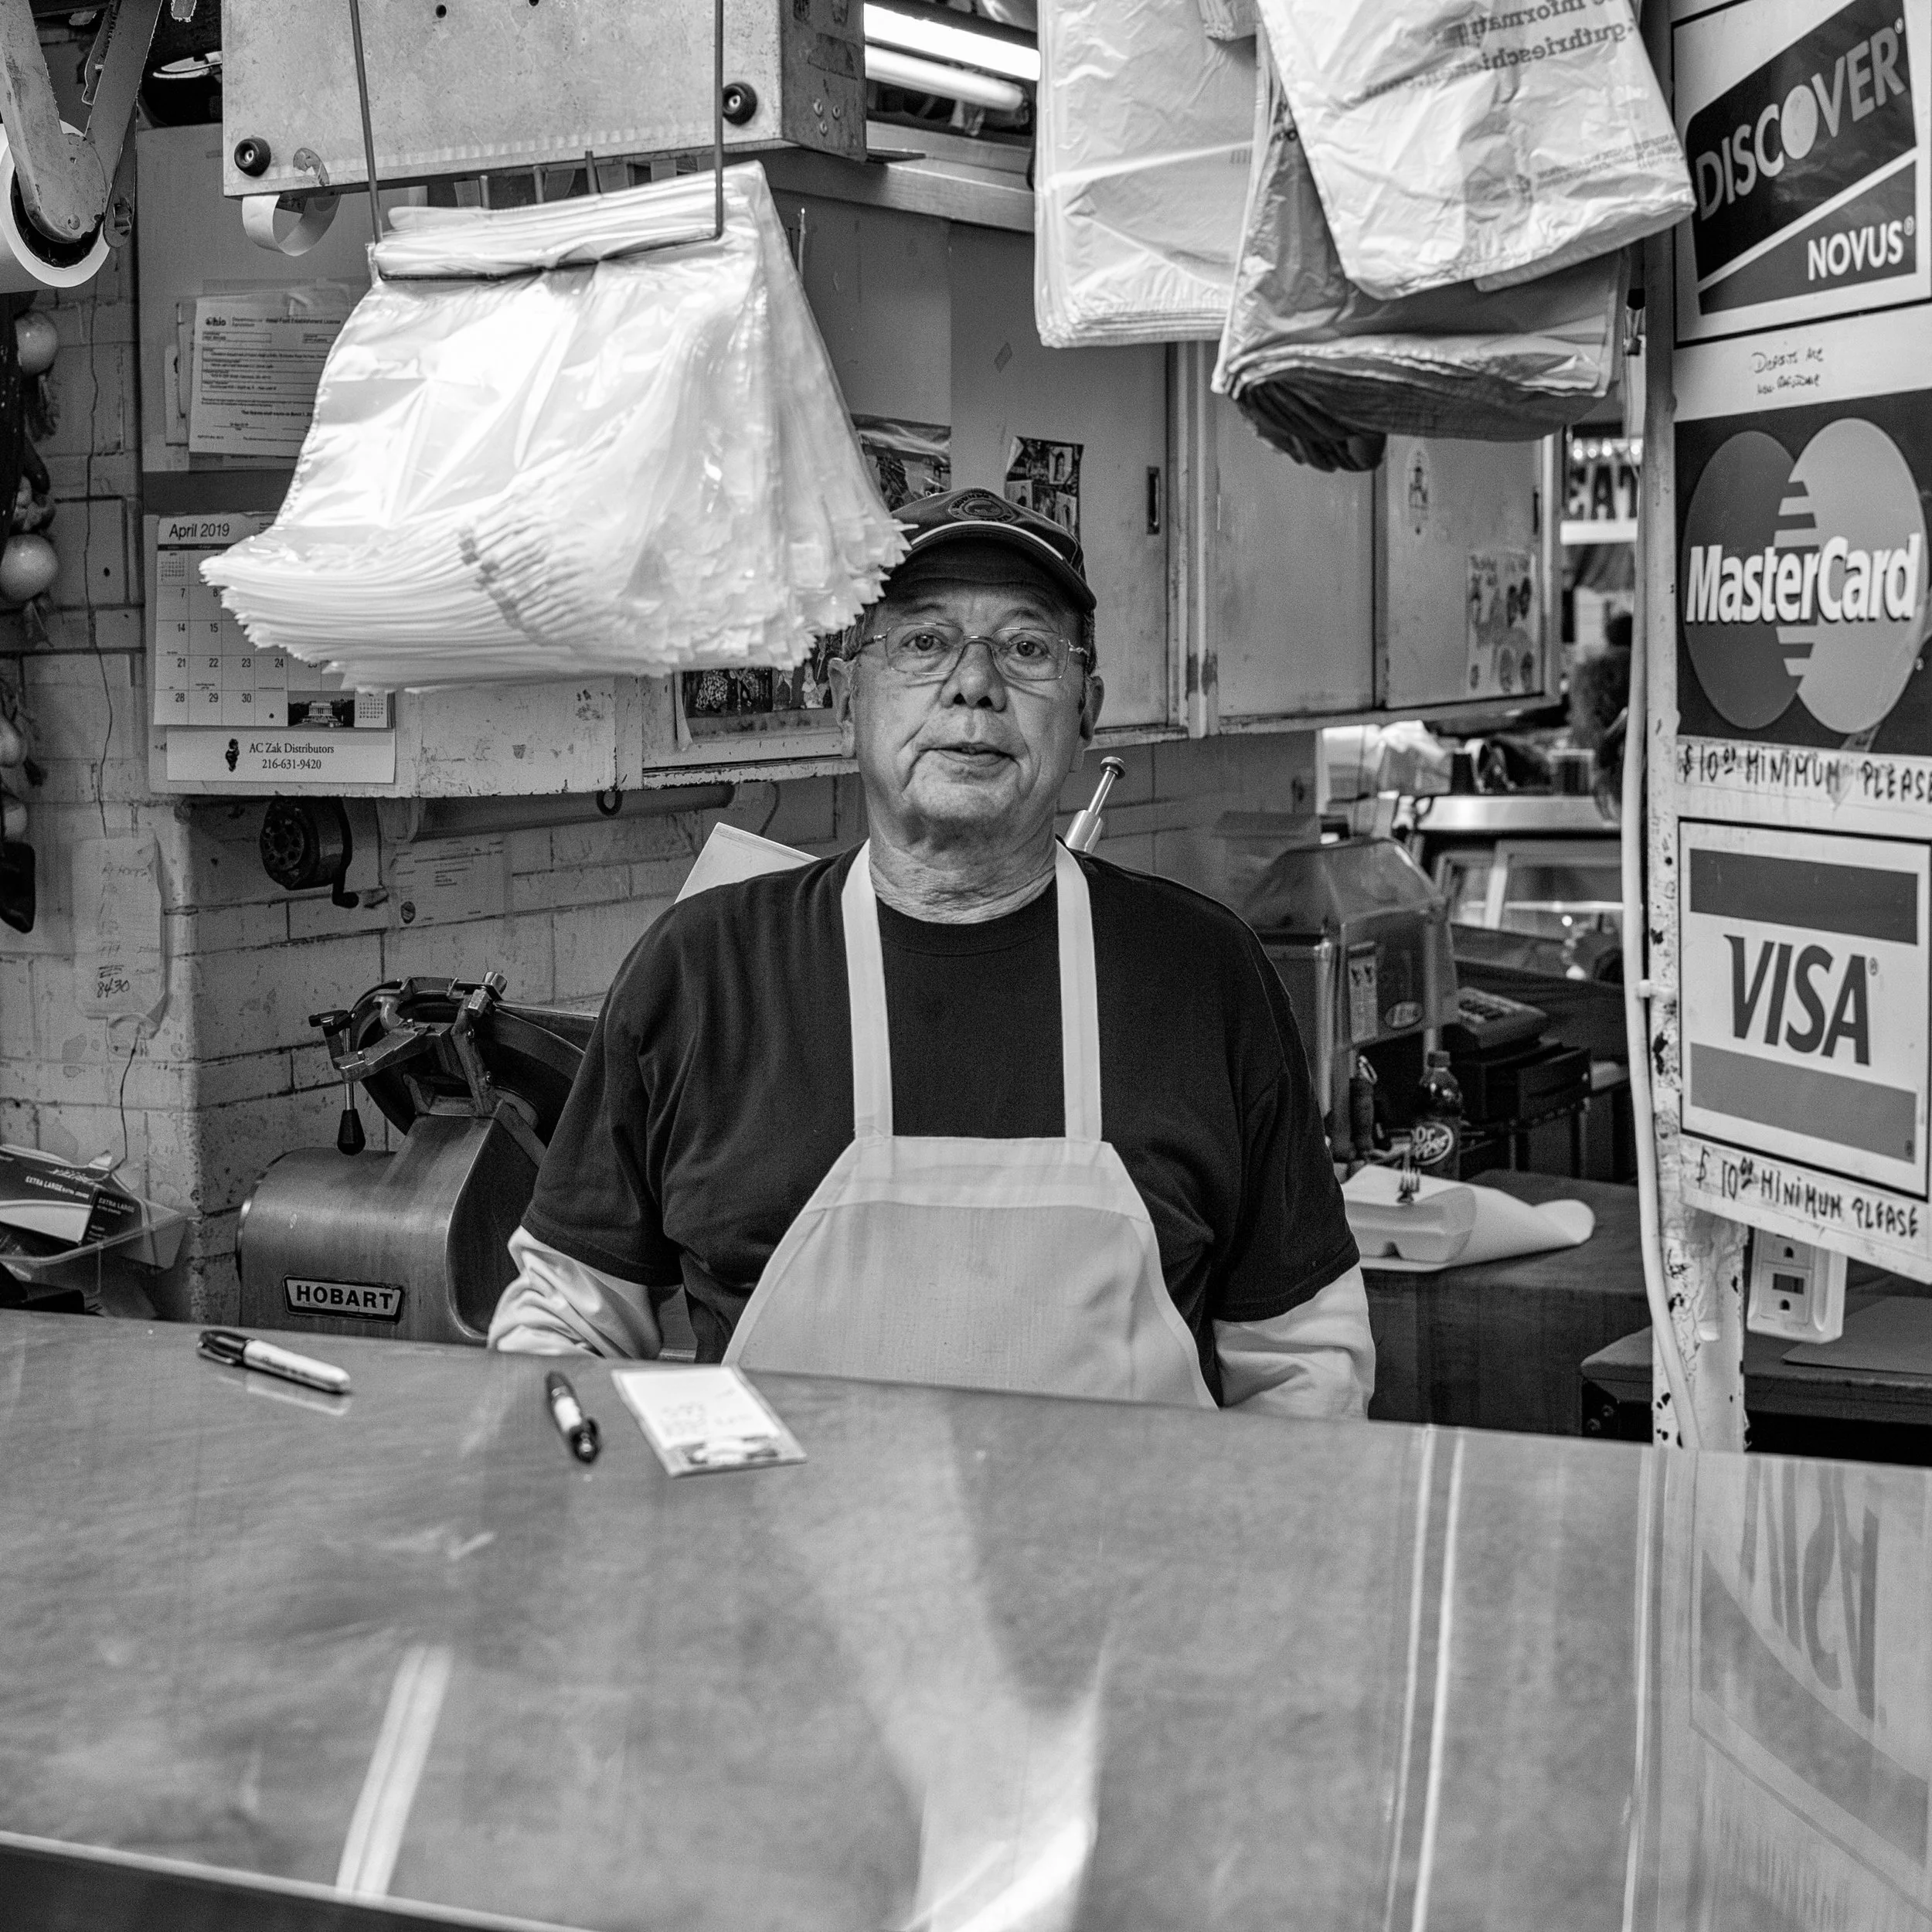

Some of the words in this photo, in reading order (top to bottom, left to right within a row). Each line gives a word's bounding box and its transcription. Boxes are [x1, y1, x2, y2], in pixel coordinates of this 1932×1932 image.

[1695, 29, 1906, 221] DISCOVER
[1808, 221, 1903, 281] NOVUS
[169, 523, 197, 540] April
[200, 522, 230, 536] 2019
[1686, 533, 1921, 624] MasterCard
[181, 587, 185, 597] 7
[177, 623, 185, 633] 14
[209, 623, 219, 633] 15
[177, 658, 186, 668] 21
[209, 658, 219, 668] 22
[241, 658, 251, 668] 23
[274, 658, 284, 668] 24
[175, 692, 185, 702] 28
[209, 692, 219, 702] 29
[241, 692, 252, 702] 30
[249, 743, 264, 753] AC
[265, 743, 281, 753] Zak
[284, 743, 335, 754] Distributors
[262, 758, 321, 770] 216-631-9420
[96, 978, 130, 998] 8430
[1723, 934, 1871, 1067] VISA
[1852, 1197, 1919, 1239] PLEASE
[297, 1284, 393, 1310] HOBART
